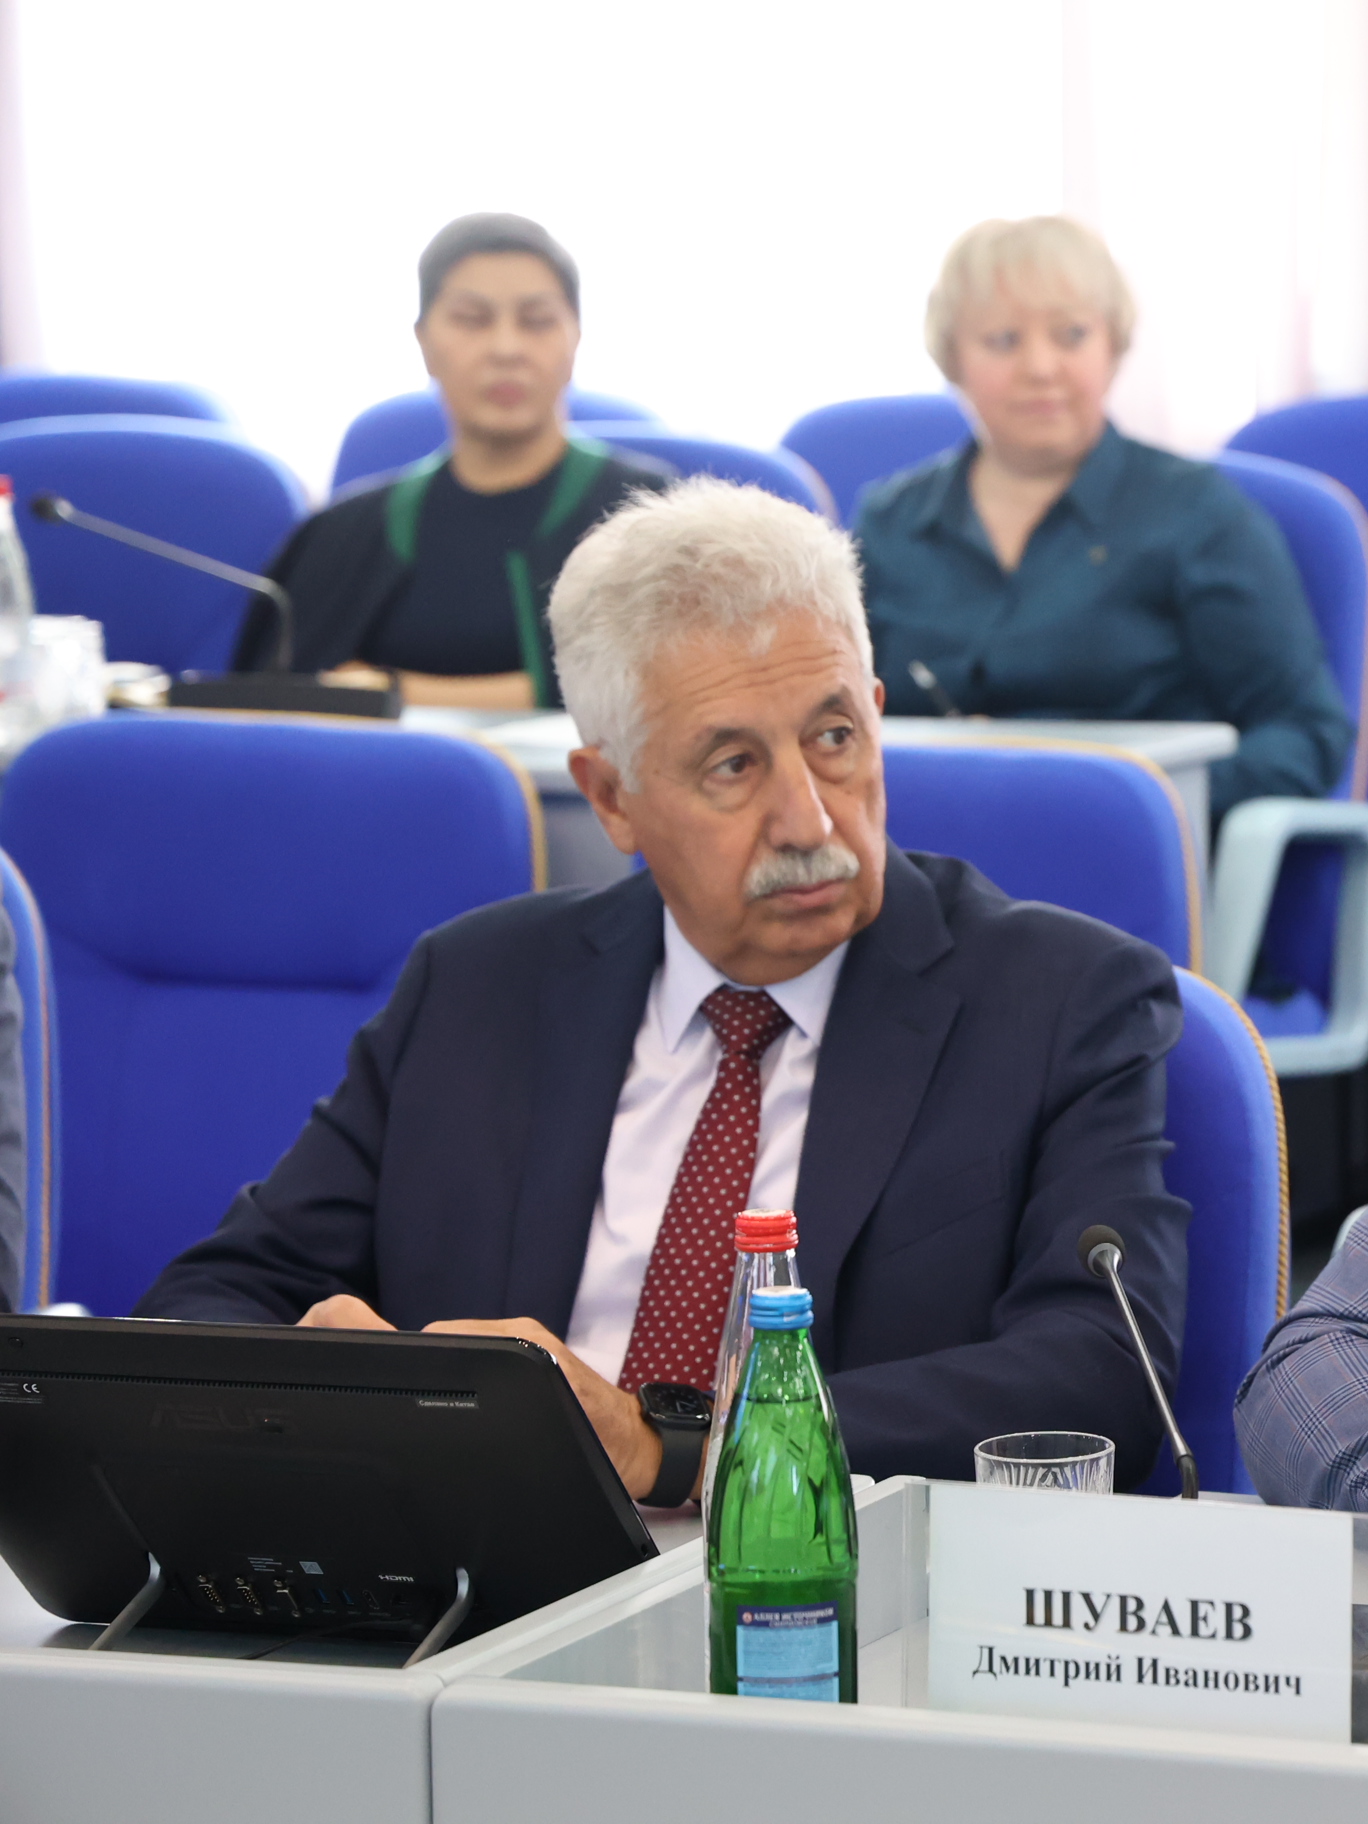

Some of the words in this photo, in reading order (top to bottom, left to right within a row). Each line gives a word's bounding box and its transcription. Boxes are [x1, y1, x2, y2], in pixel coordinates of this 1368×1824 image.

[1023, 1587, 1254, 1641] ШУВАЕВ
[972, 1644, 1123, 1687] Дмитрий
[1135, 1655, 1302, 1697] Иванович
